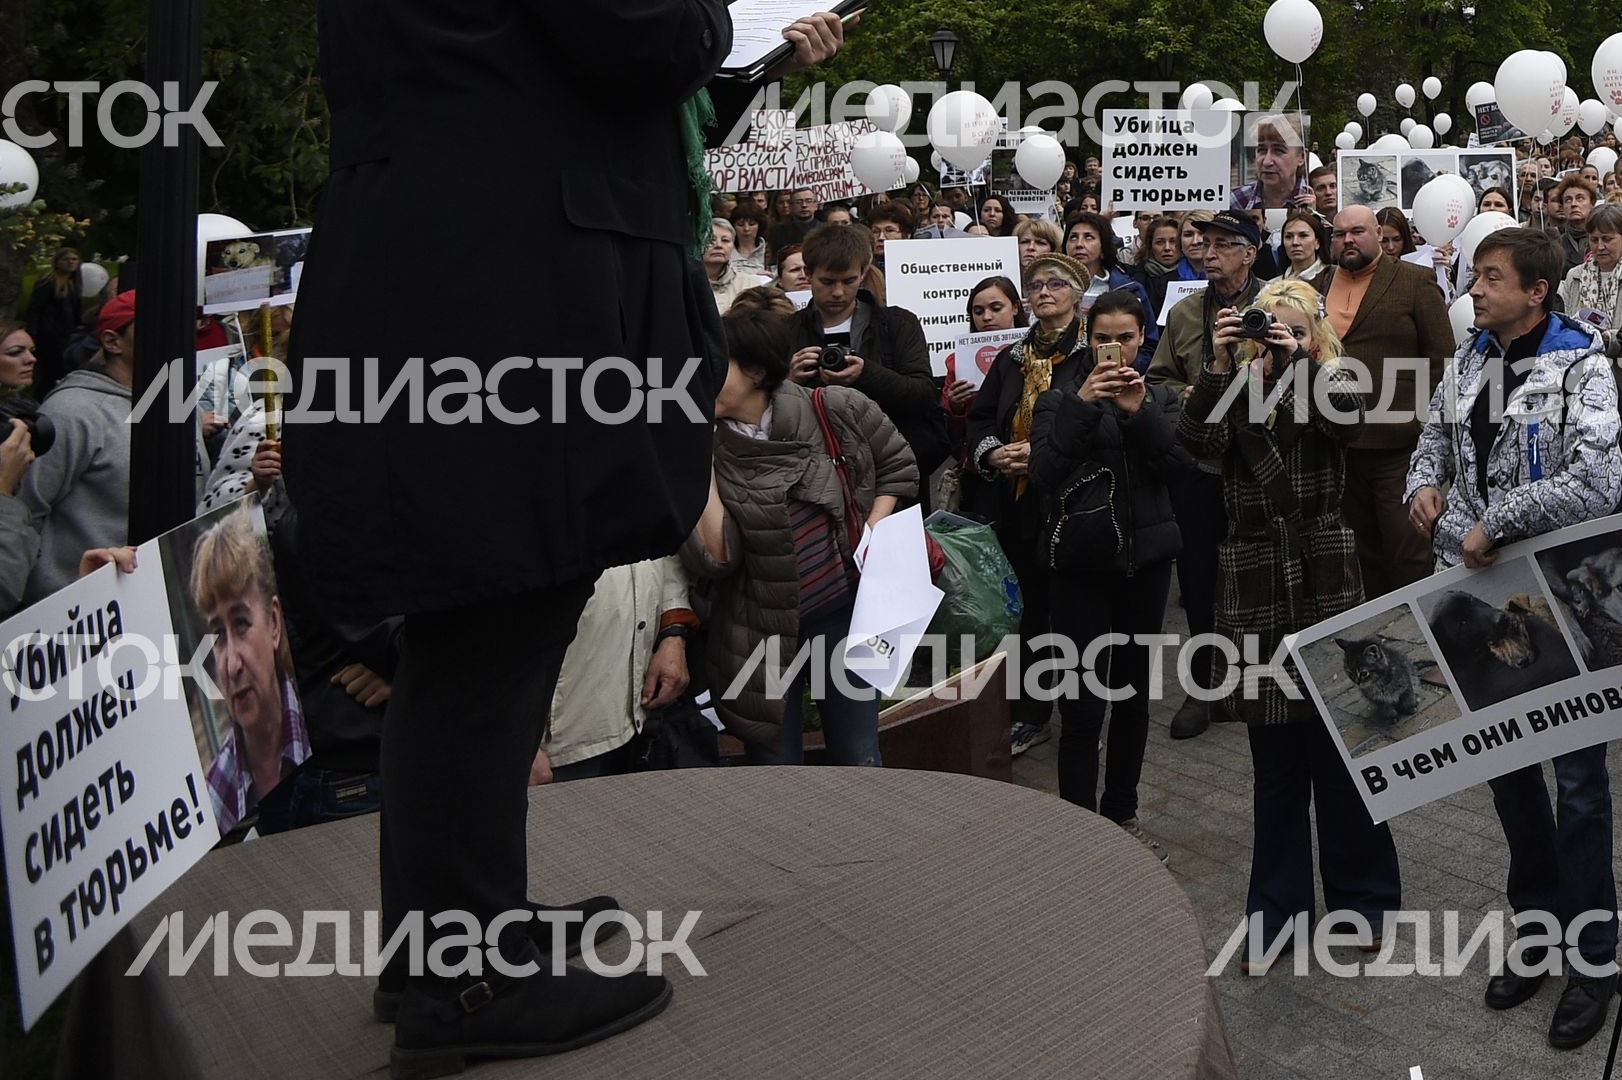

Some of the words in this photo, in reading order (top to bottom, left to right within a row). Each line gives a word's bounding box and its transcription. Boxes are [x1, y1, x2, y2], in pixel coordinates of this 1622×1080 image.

[1113, 115, 1194, 135] Убийца
[709, 153, 787, 169] РОССИИ
[1112, 143, 1197, 159] должен
[738, 167, 796, 191] ВЛАСТИ
[1112, 166, 1188, 181] сидеть
[1112, 190, 1124, 201] в
[1130, 185, 1224, 205] тюрьме!
[901, 259, 1003, 275] Общественный
[923, 287, 974, 300] контро
[916, 313, 971, 327] униципа
[958, 337, 969, 346] НЕТ
[970, 335, 993, 345] ЗАКОНУ
[994, 334, 1001, 342] ОБ
[9, 597, 123, 712] Убийца
[867, 635, 895, 659] ОВ!
[16, 668, 138, 811] должен
[1360, 765, 1388, 795] В
[1392, 742, 1457, 782] чем
[1462, 718, 1523, 756] они
[24, 761, 136, 885] сидеть
[34, 919, 55, 976] в
[60, 773, 206, 943] тюрьме!
